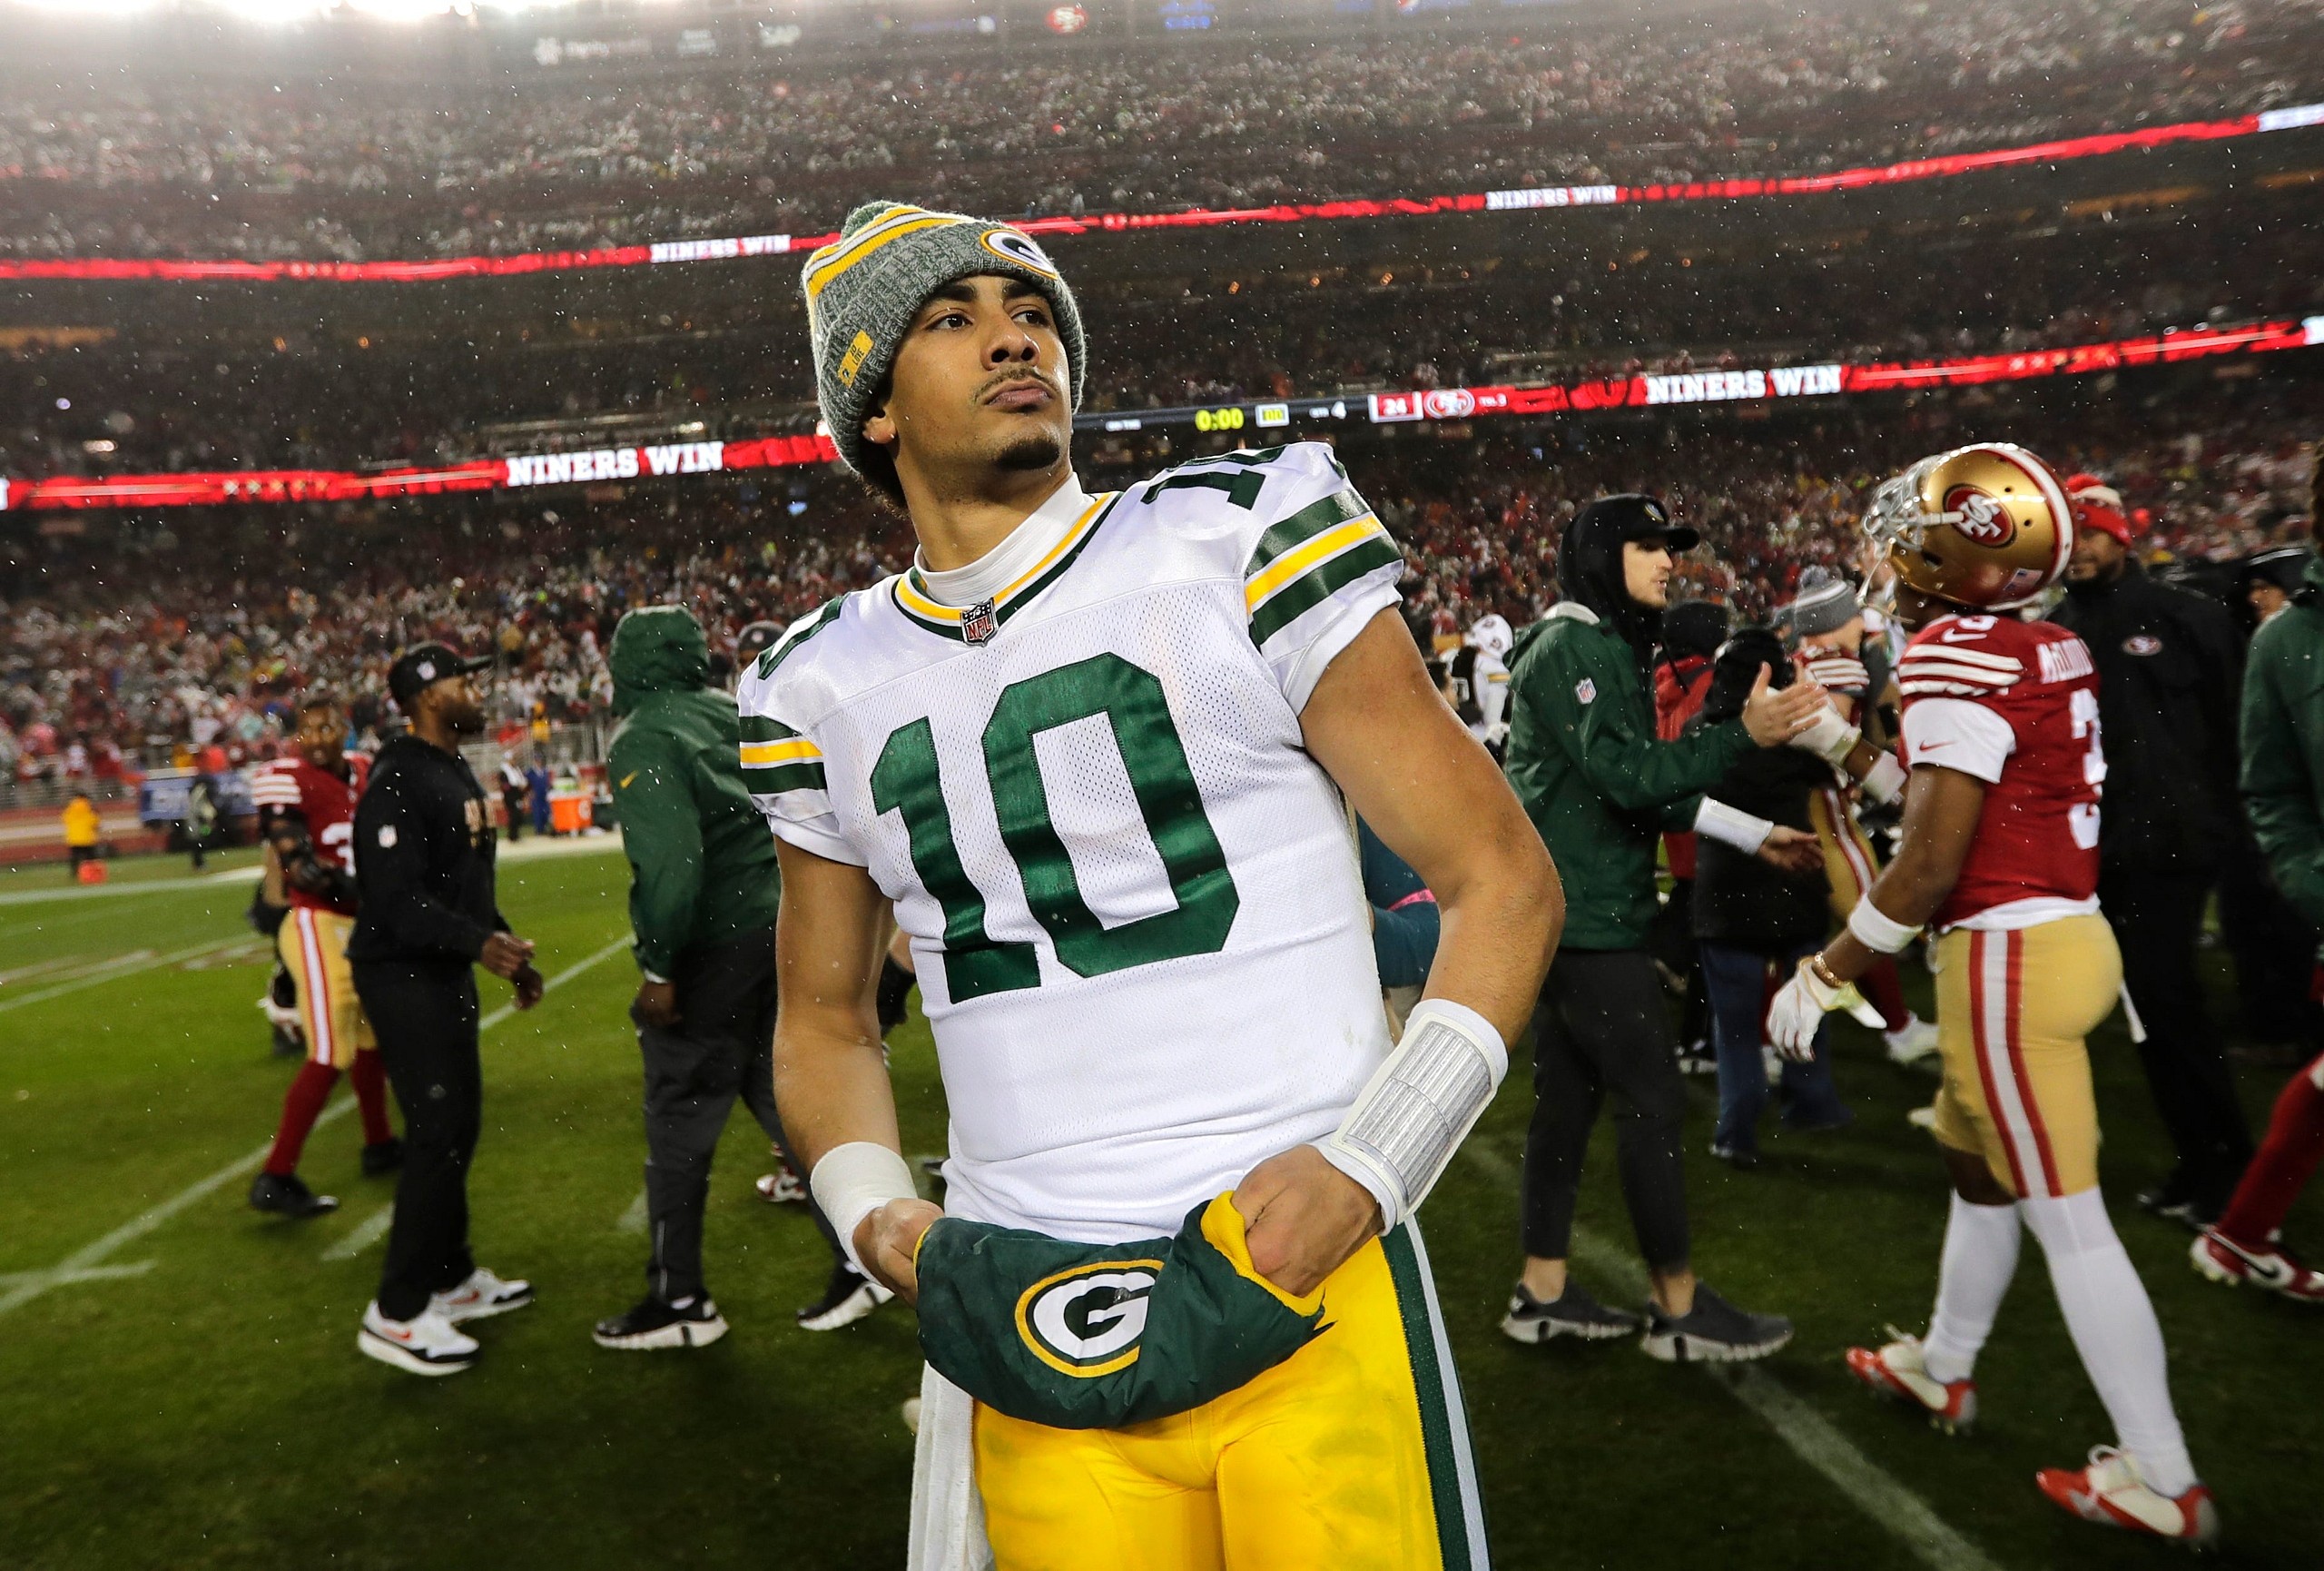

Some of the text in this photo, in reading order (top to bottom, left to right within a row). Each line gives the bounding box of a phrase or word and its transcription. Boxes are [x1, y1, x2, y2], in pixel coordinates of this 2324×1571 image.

[1485, 185, 1617, 210] NINERS WIN
[650, 234, 792, 263] NINERS WIN
[1647, 365, 1842, 404] NINERS WIN
[1195, 407, 1245, 431] 0:00
[1330, 400, 1347, 420] 4
[1382, 398, 1408, 417] 24
[507, 441, 724, 487] NINERS WIN
[966, 617, 993, 639] NFL
[870, 651, 1240, 1004] 10
[1032, 1272, 1157, 1359] G
